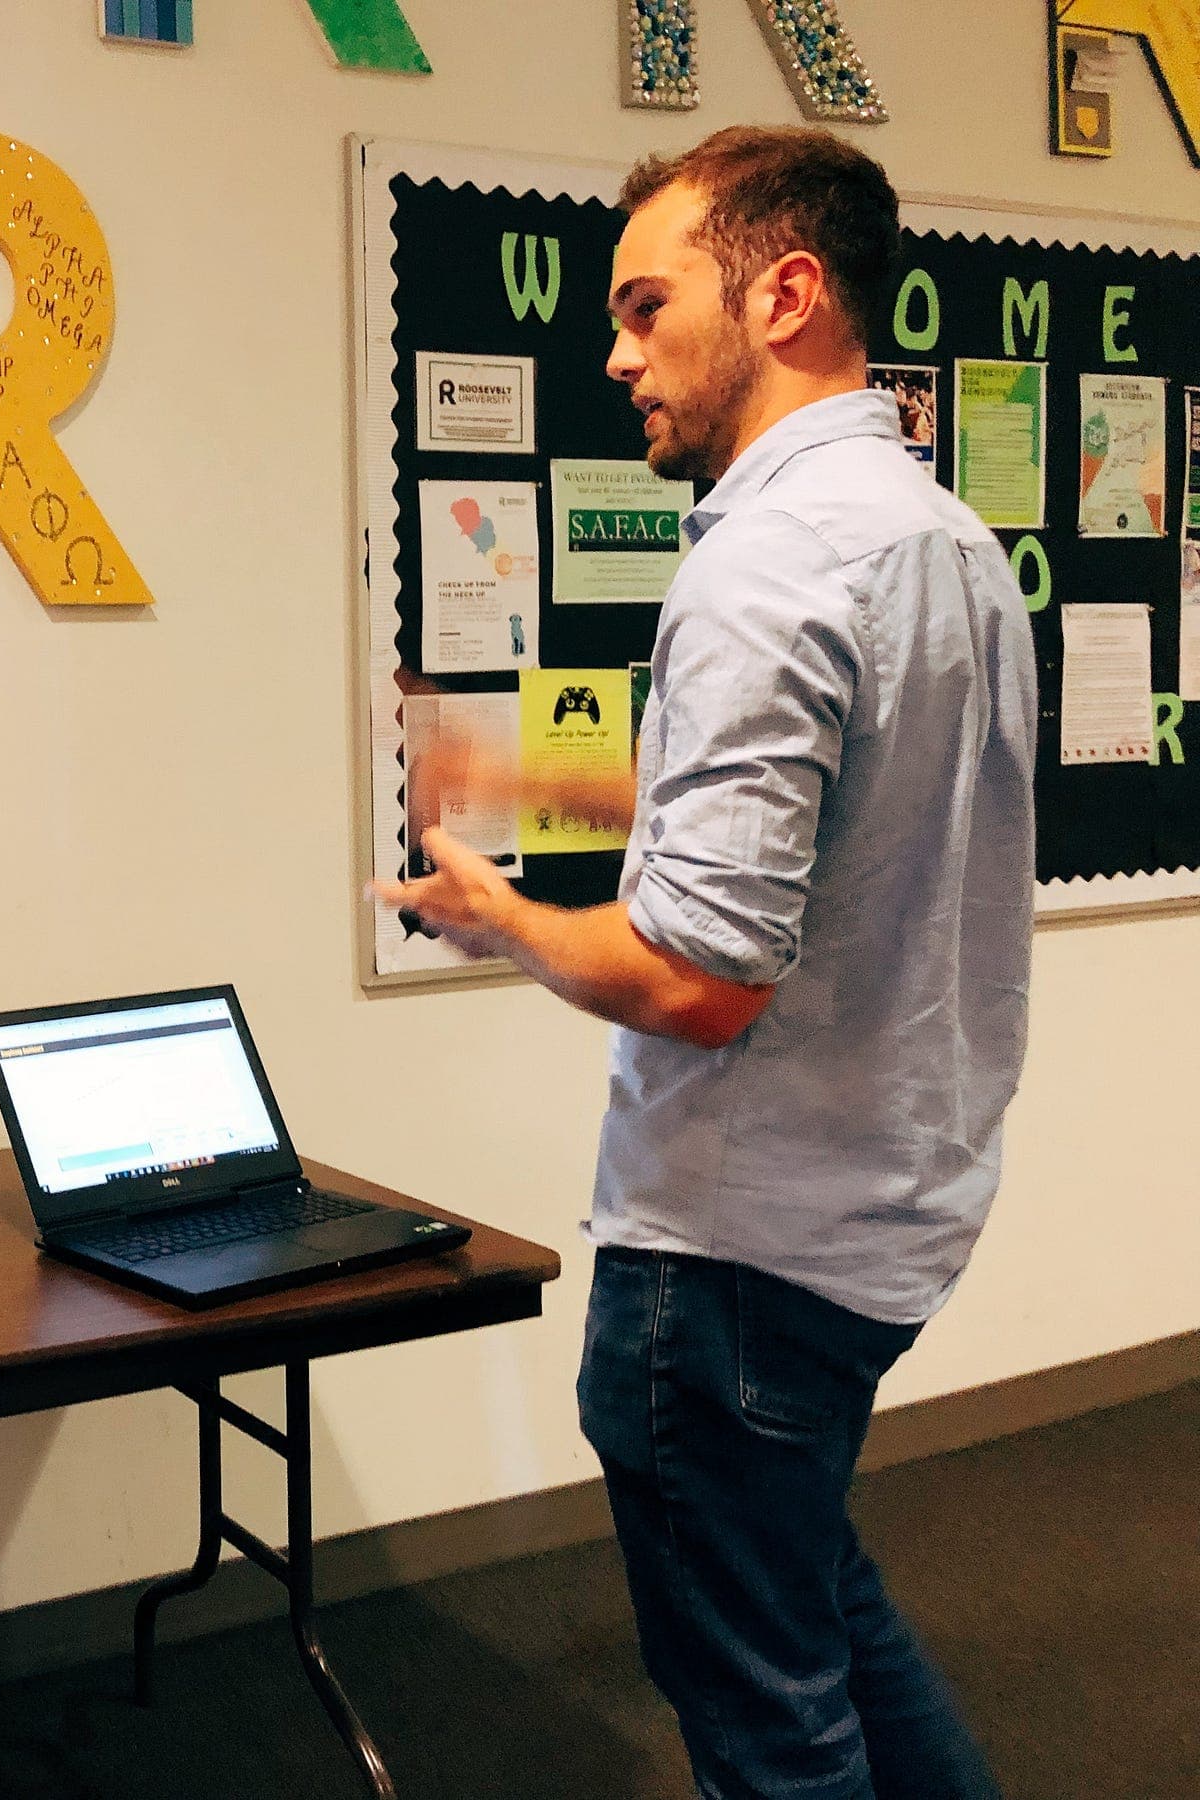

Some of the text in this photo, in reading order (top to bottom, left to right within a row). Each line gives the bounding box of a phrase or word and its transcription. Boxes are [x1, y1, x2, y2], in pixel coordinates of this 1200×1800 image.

[12, 199, 108, 294] ALPHA
[26, 286, 103, 353] OMEGA
[458, 383, 512, 395] ROOSEVELT
[458, 394, 512, 404] UNIVERSITY
[563, 471, 591, 483] WANT
[570, 513, 676, 541] S.A.F.A.C.
